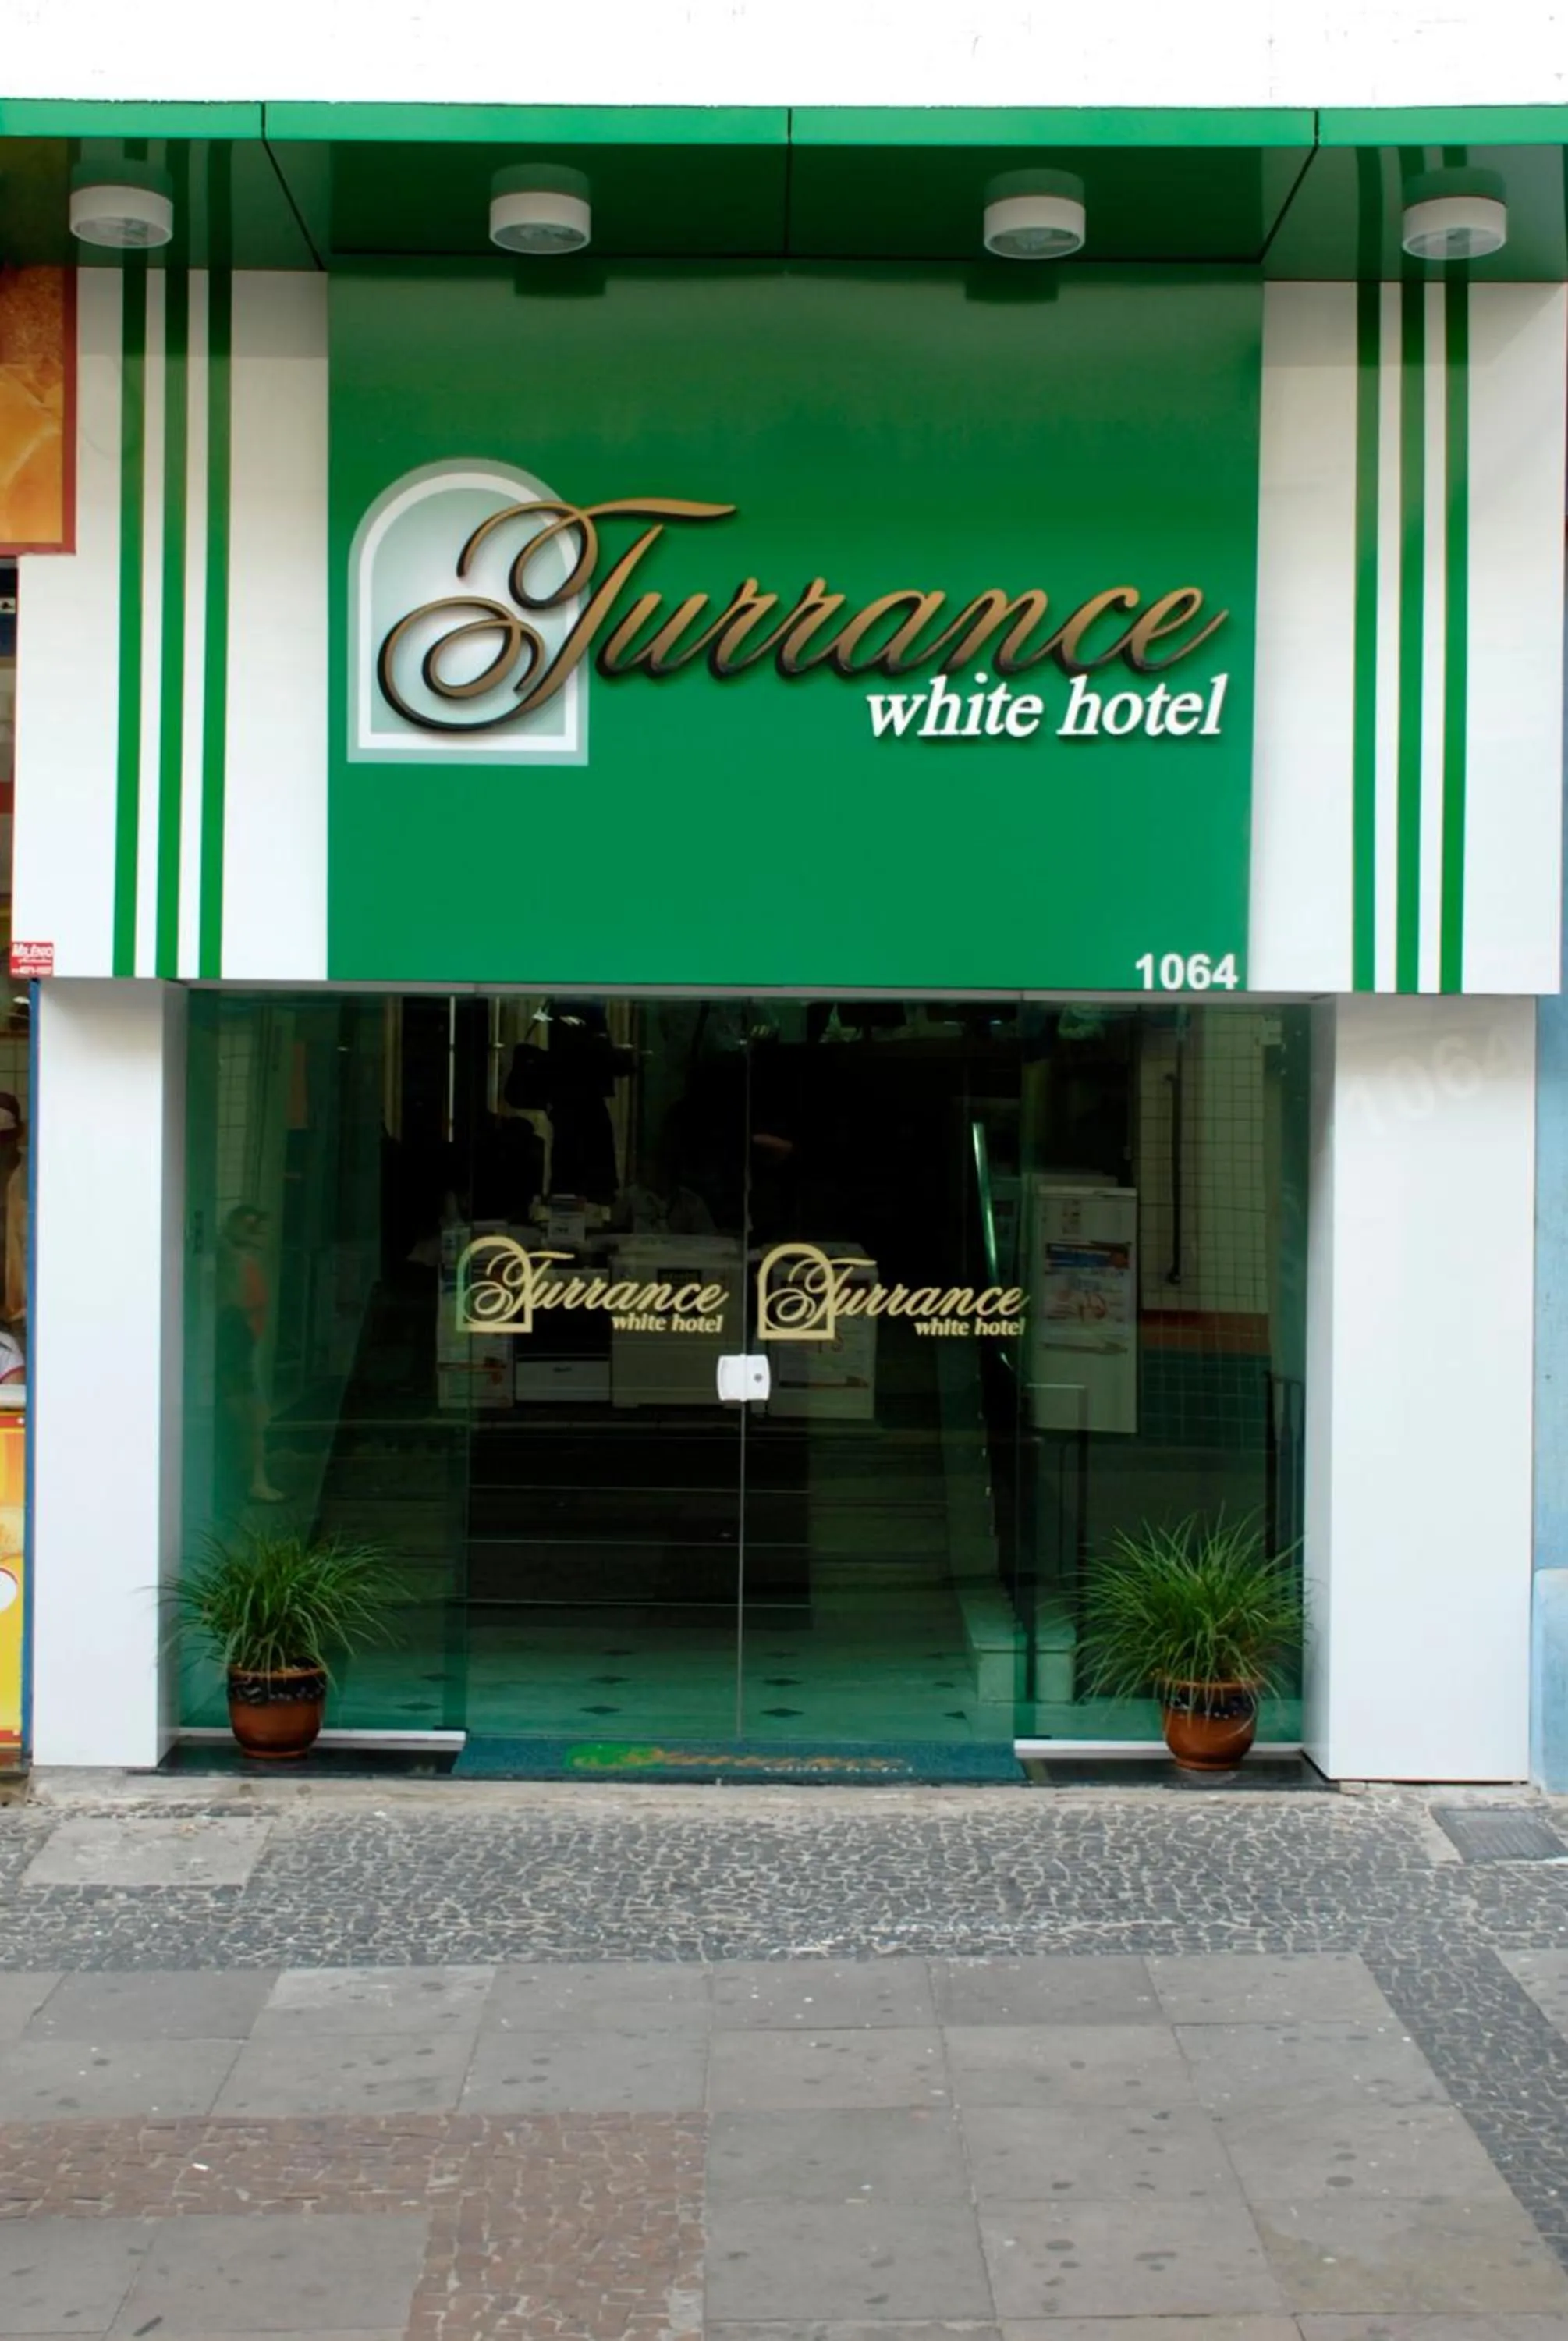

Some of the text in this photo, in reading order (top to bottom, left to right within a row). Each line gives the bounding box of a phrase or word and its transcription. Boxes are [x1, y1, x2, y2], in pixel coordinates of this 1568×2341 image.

[378, 496, 1229, 732] Turrance
[867, 673, 1229, 737] white hotel
[1135, 953, 1239, 990] 1064
[463, 1251, 729, 1324] Turrance
[765, 1258, 1031, 1330] Turrance
[612, 1312, 724, 1333] white hotel
[913, 1316, 1026, 1337] white hotel
